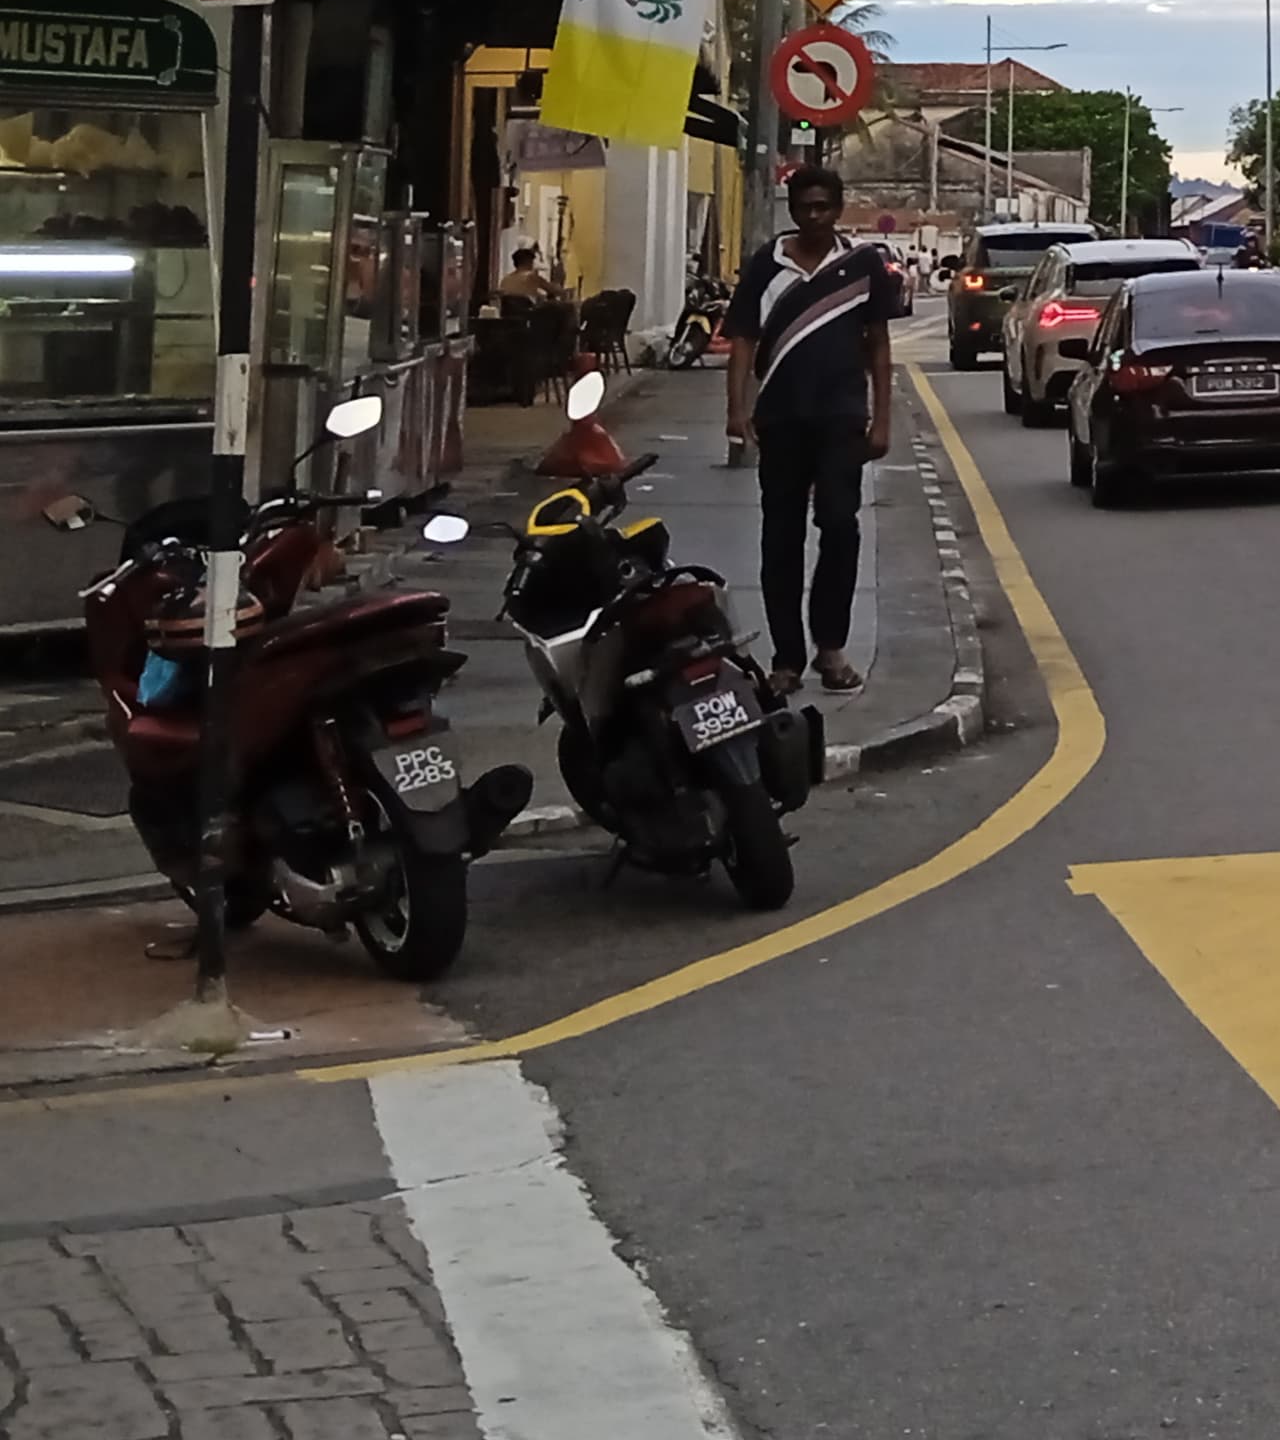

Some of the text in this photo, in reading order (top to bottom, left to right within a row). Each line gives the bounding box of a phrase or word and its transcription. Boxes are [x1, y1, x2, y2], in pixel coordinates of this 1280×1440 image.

[0, 21, 148, 69] MUSTAFA
[692, 706, 749, 739] 3954
[395, 746, 443, 774] PPC
[395, 760, 456, 792] 2283
